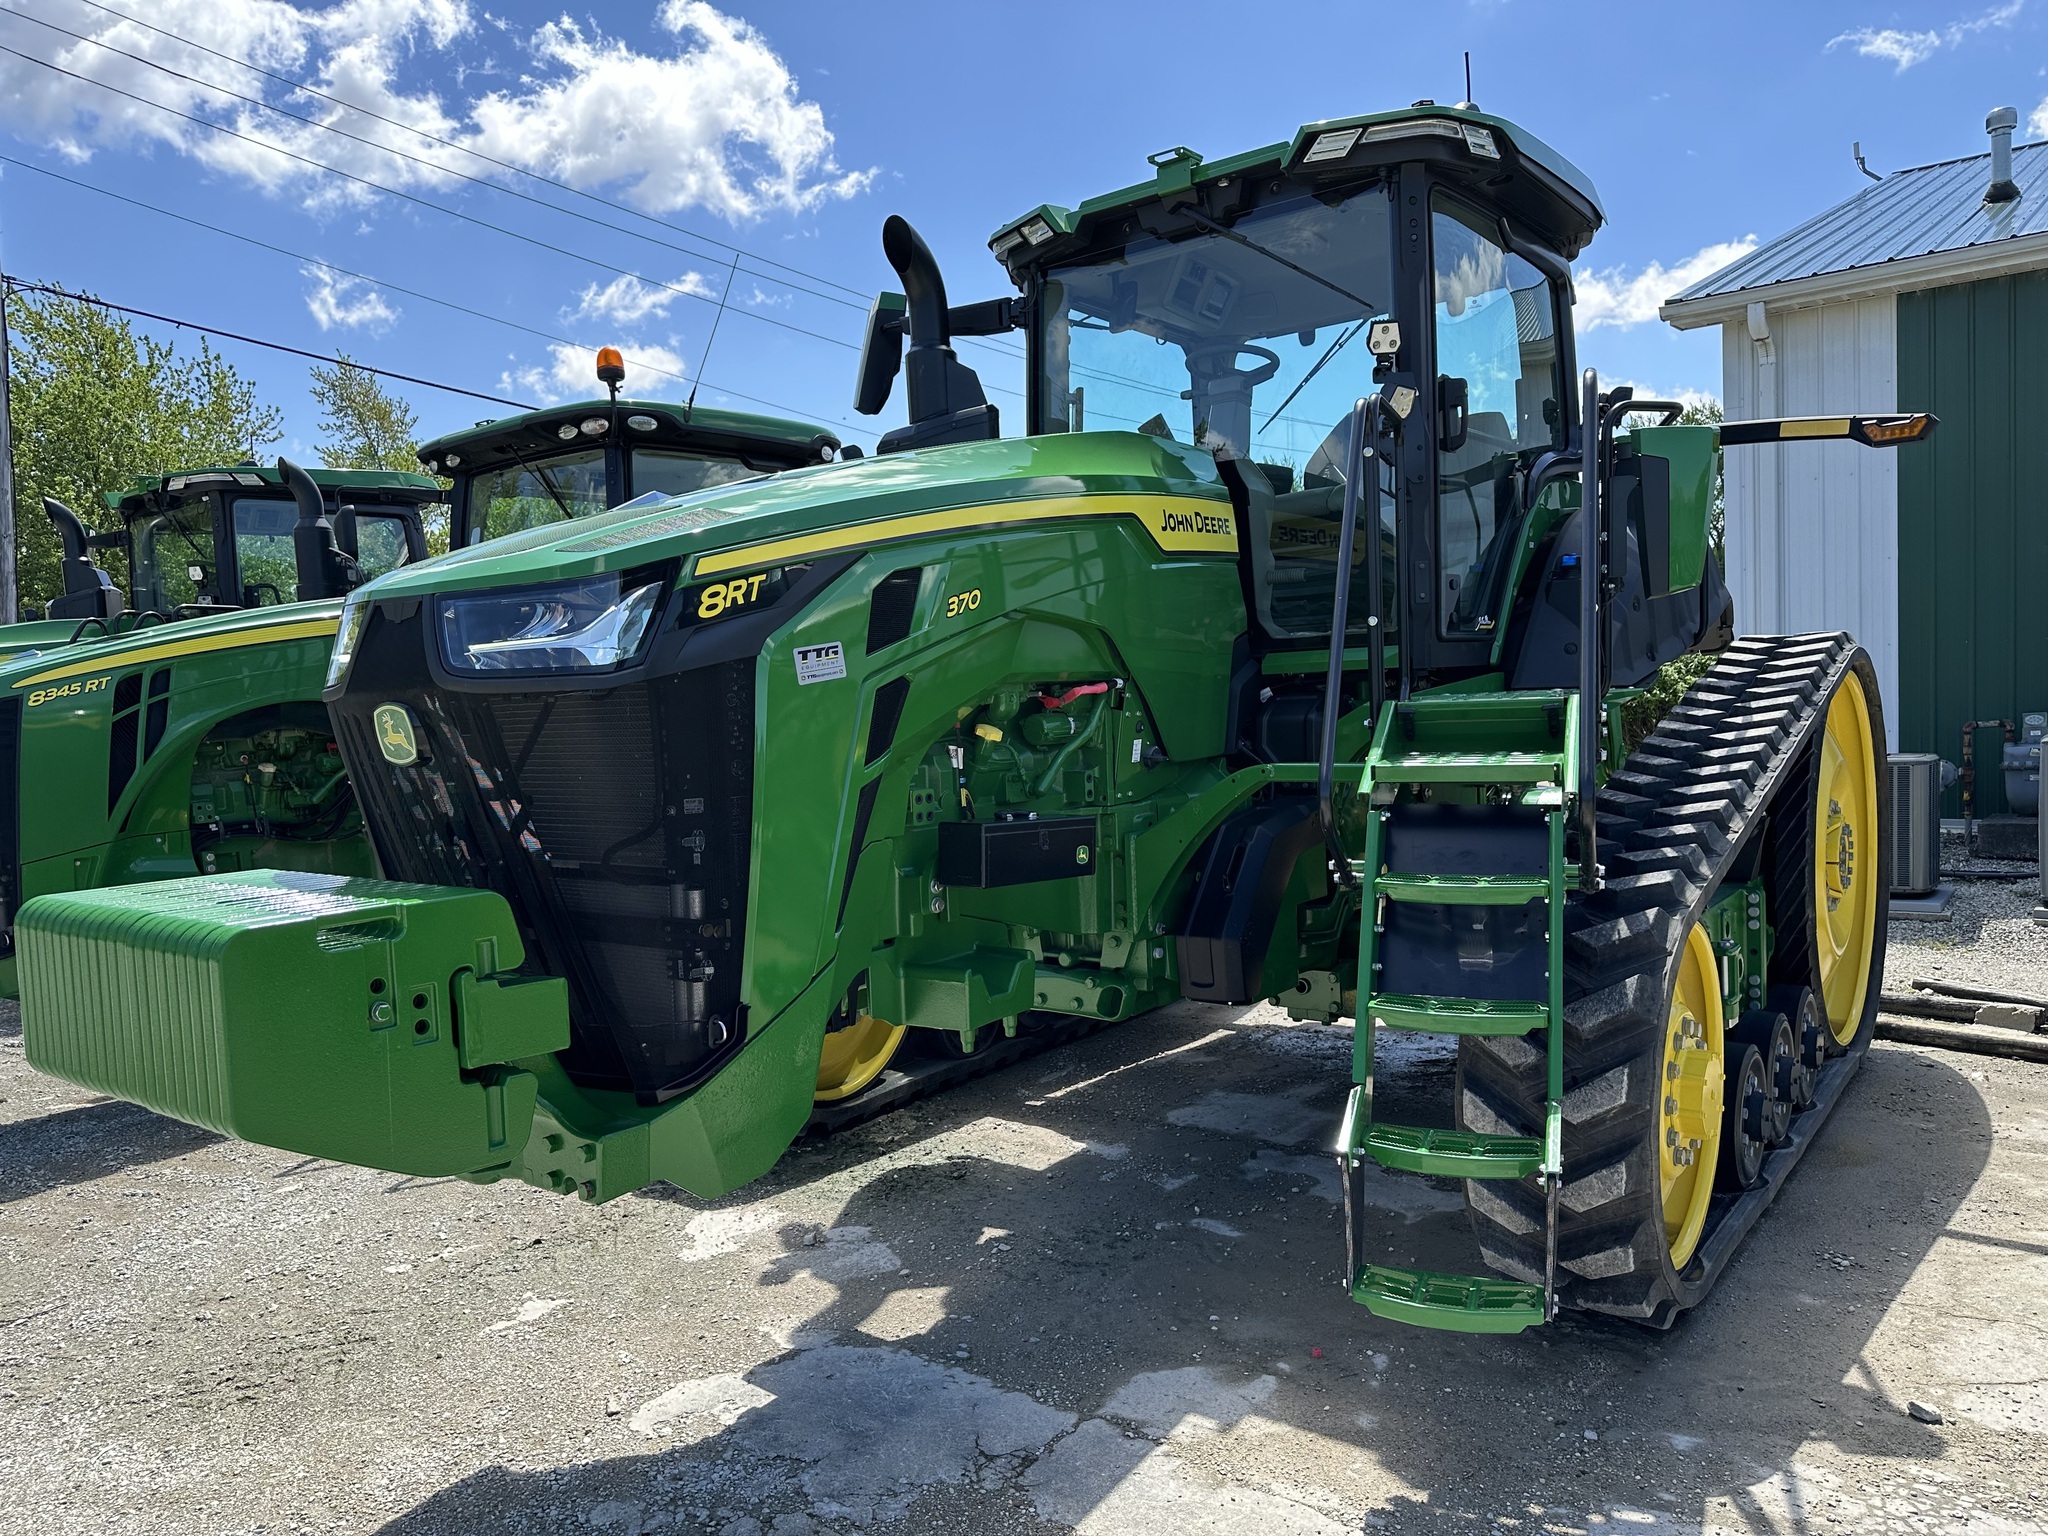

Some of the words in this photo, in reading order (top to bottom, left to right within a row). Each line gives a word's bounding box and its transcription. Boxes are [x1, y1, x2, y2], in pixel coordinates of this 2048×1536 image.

[1161, 508, 1194, 532] JOHN
[1194, 511, 1231, 535] DEERE
[697, 573, 767, 619] 8RT
[946, 588, 981, 618] 370
[797, 645, 839, 664] TTG
[801, 660, 839, 671] EQUIPMENT
[27, 682, 82, 707] 8345
[84, 676, 112, 693] RT
